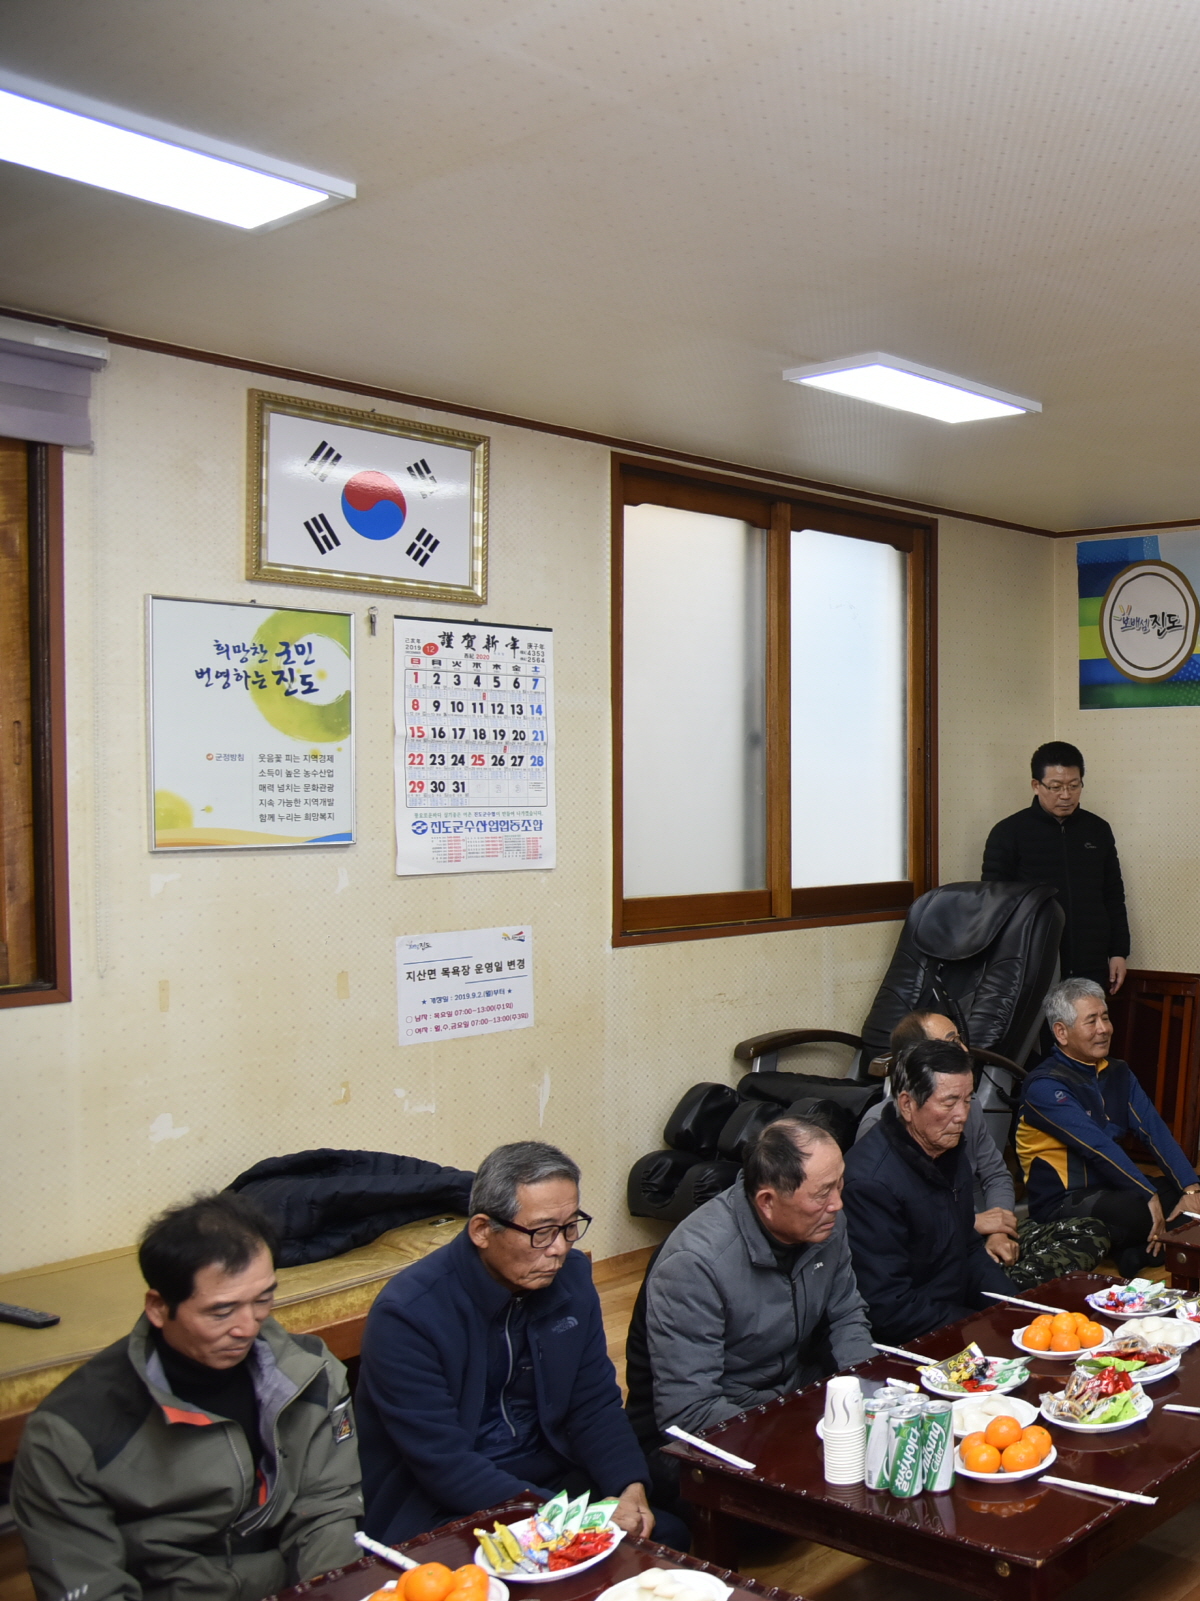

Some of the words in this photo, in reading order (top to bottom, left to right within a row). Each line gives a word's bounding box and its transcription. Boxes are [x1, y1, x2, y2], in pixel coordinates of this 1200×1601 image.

[1149, 611, 1184, 638] 진도
[213, 639, 268, 663] 희망찬
[275, 641, 315, 666] 군민
[452, 660, 462, 668] 火
[512, 664, 521, 672] 金
[194, 667, 267, 690] 번영하는
[271, 667, 320, 697] 진도
[413, 672, 419, 683] 1
[433, 673, 440, 685] 2
[453, 674, 461, 686] 3
[473, 675, 481, 687] 4
[493, 676, 501, 688] 5
[513, 677, 520, 689] 6
[532, 678, 539, 690] 7
[412, 699, 420, 711] 8
[433, 700, 440, 712] 9
[450, 701, 464, 713] 10
[472, 702, 484, 714] 11
[491, 703, 504, 715] 12
[510, 704, 523, 716] 13
[530, 704, 543, 716] 14
[409, 726, 425, 738] 15
[431, 727, 446, 739] 16
[452, 728, 466, 740] 17
[473, 728, 486, 740] 18
[493, 729, 506, 740] 19
[512, 730, 526, 741] 20
[532, 730, 544, 742] 21
[215, 753, 245, 762] 군정방침
[258, 753, 282, 763] 웃음꽃
[285, 754, 300, 763] 피는
[303, 754, 334, 763] 지역경제
[408, 753, 424, 766] 22
[429, 753, 446, 766] 23
[451, 754, 465, 766] 24
[471, 754, 485, 766] 25
[491, 755, 505, 766] 26
[510, 755, 525, 767] 27
[530, 755, 544, 767] 28
[258, 769, 282, 778] 소득이
[285, 769, 300, 778] 높은
[303, 769, 334, 778] 농수산업
[259, 784, 275, 793] 매력
[277, 784, 301, 792] 넘치는
[303, 784, 334, 792] 문화관광
[409, 780, 425, 793] 29
[430, 781, 446, 793] 30
[452, 781, 466, 793] 31
[259, 798, 275, 807] 지속
[277, 798, 301, 807] 가능한
[304, 798, 335, 807] 지역개발
[259, 814, 275, 822] 함께
[278, 813, 301, 822] 누리는
[304, 812, 335, 821] 희망복지
[430, 819, 543, 834] 진도군수산업협동조합
[406, 969, 436, 982] 지산면
[441, 965, 470, 978] 목욕장
[475, 961, 503, 974] 운영일
[507, 958, 525, 970] 변경
[895, 1426, 921, 1492] 칠성사이다
[922, 1421, 946, 1484] hilsung
[931, 1441, 945, 1472] Cider
